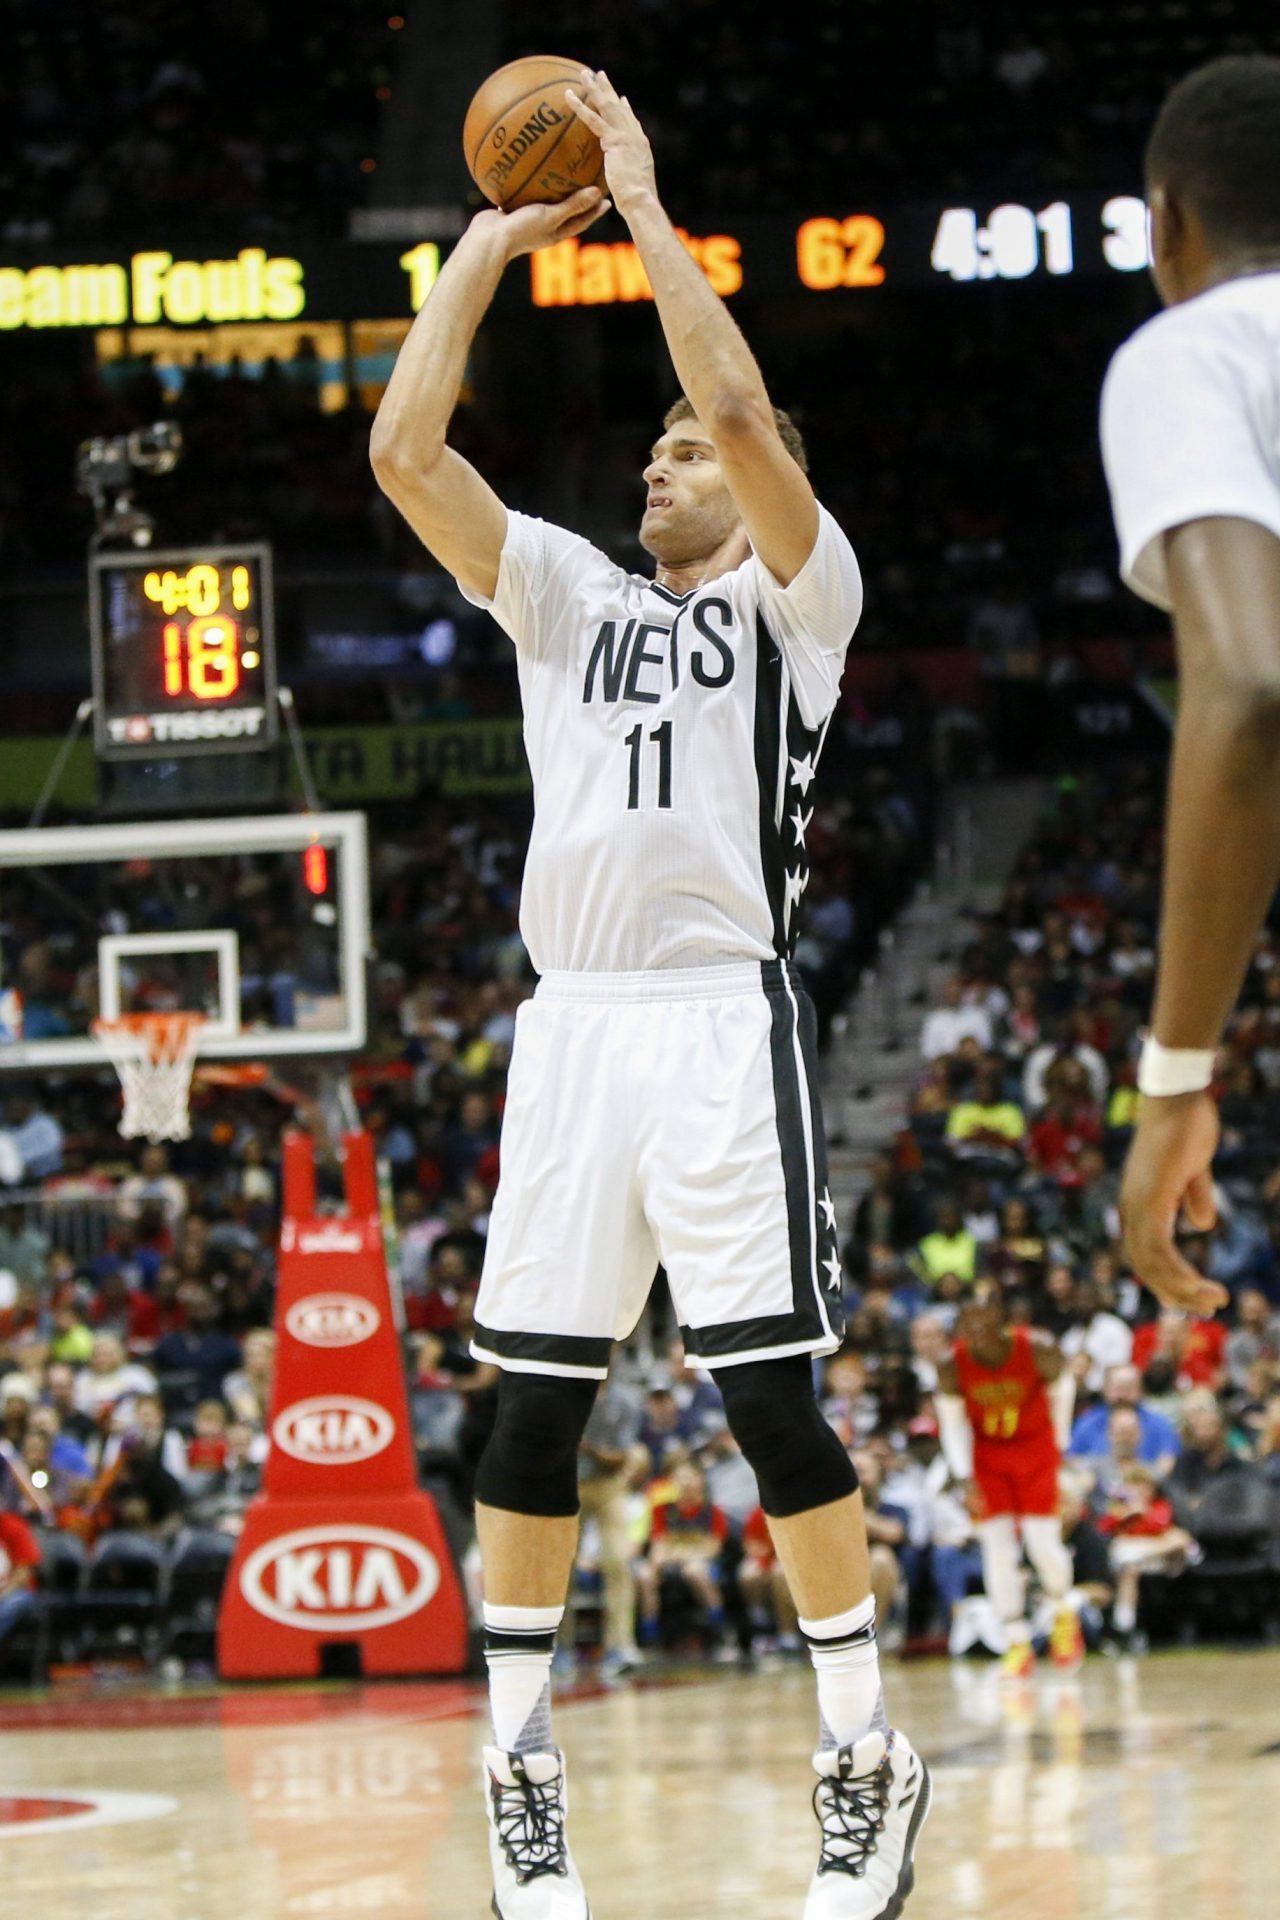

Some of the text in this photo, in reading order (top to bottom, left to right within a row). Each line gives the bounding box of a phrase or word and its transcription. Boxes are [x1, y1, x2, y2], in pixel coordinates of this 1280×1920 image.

[131, 248, 305, 324] Fouls
[530, 227, 743, 307] Haws
[796, 214, 886, 290] 62
[931, 201, 1074, 281] 4:01
[144, 565, 249, 616] 4:01
[163, 615, 240, 700] 18
[152, 706, 265, 741] TISSOT
[624, 721, 673, 810] 11
[294, 1411, 379, 1448] KIA
[275, 1547, 405, 1609] KIA
